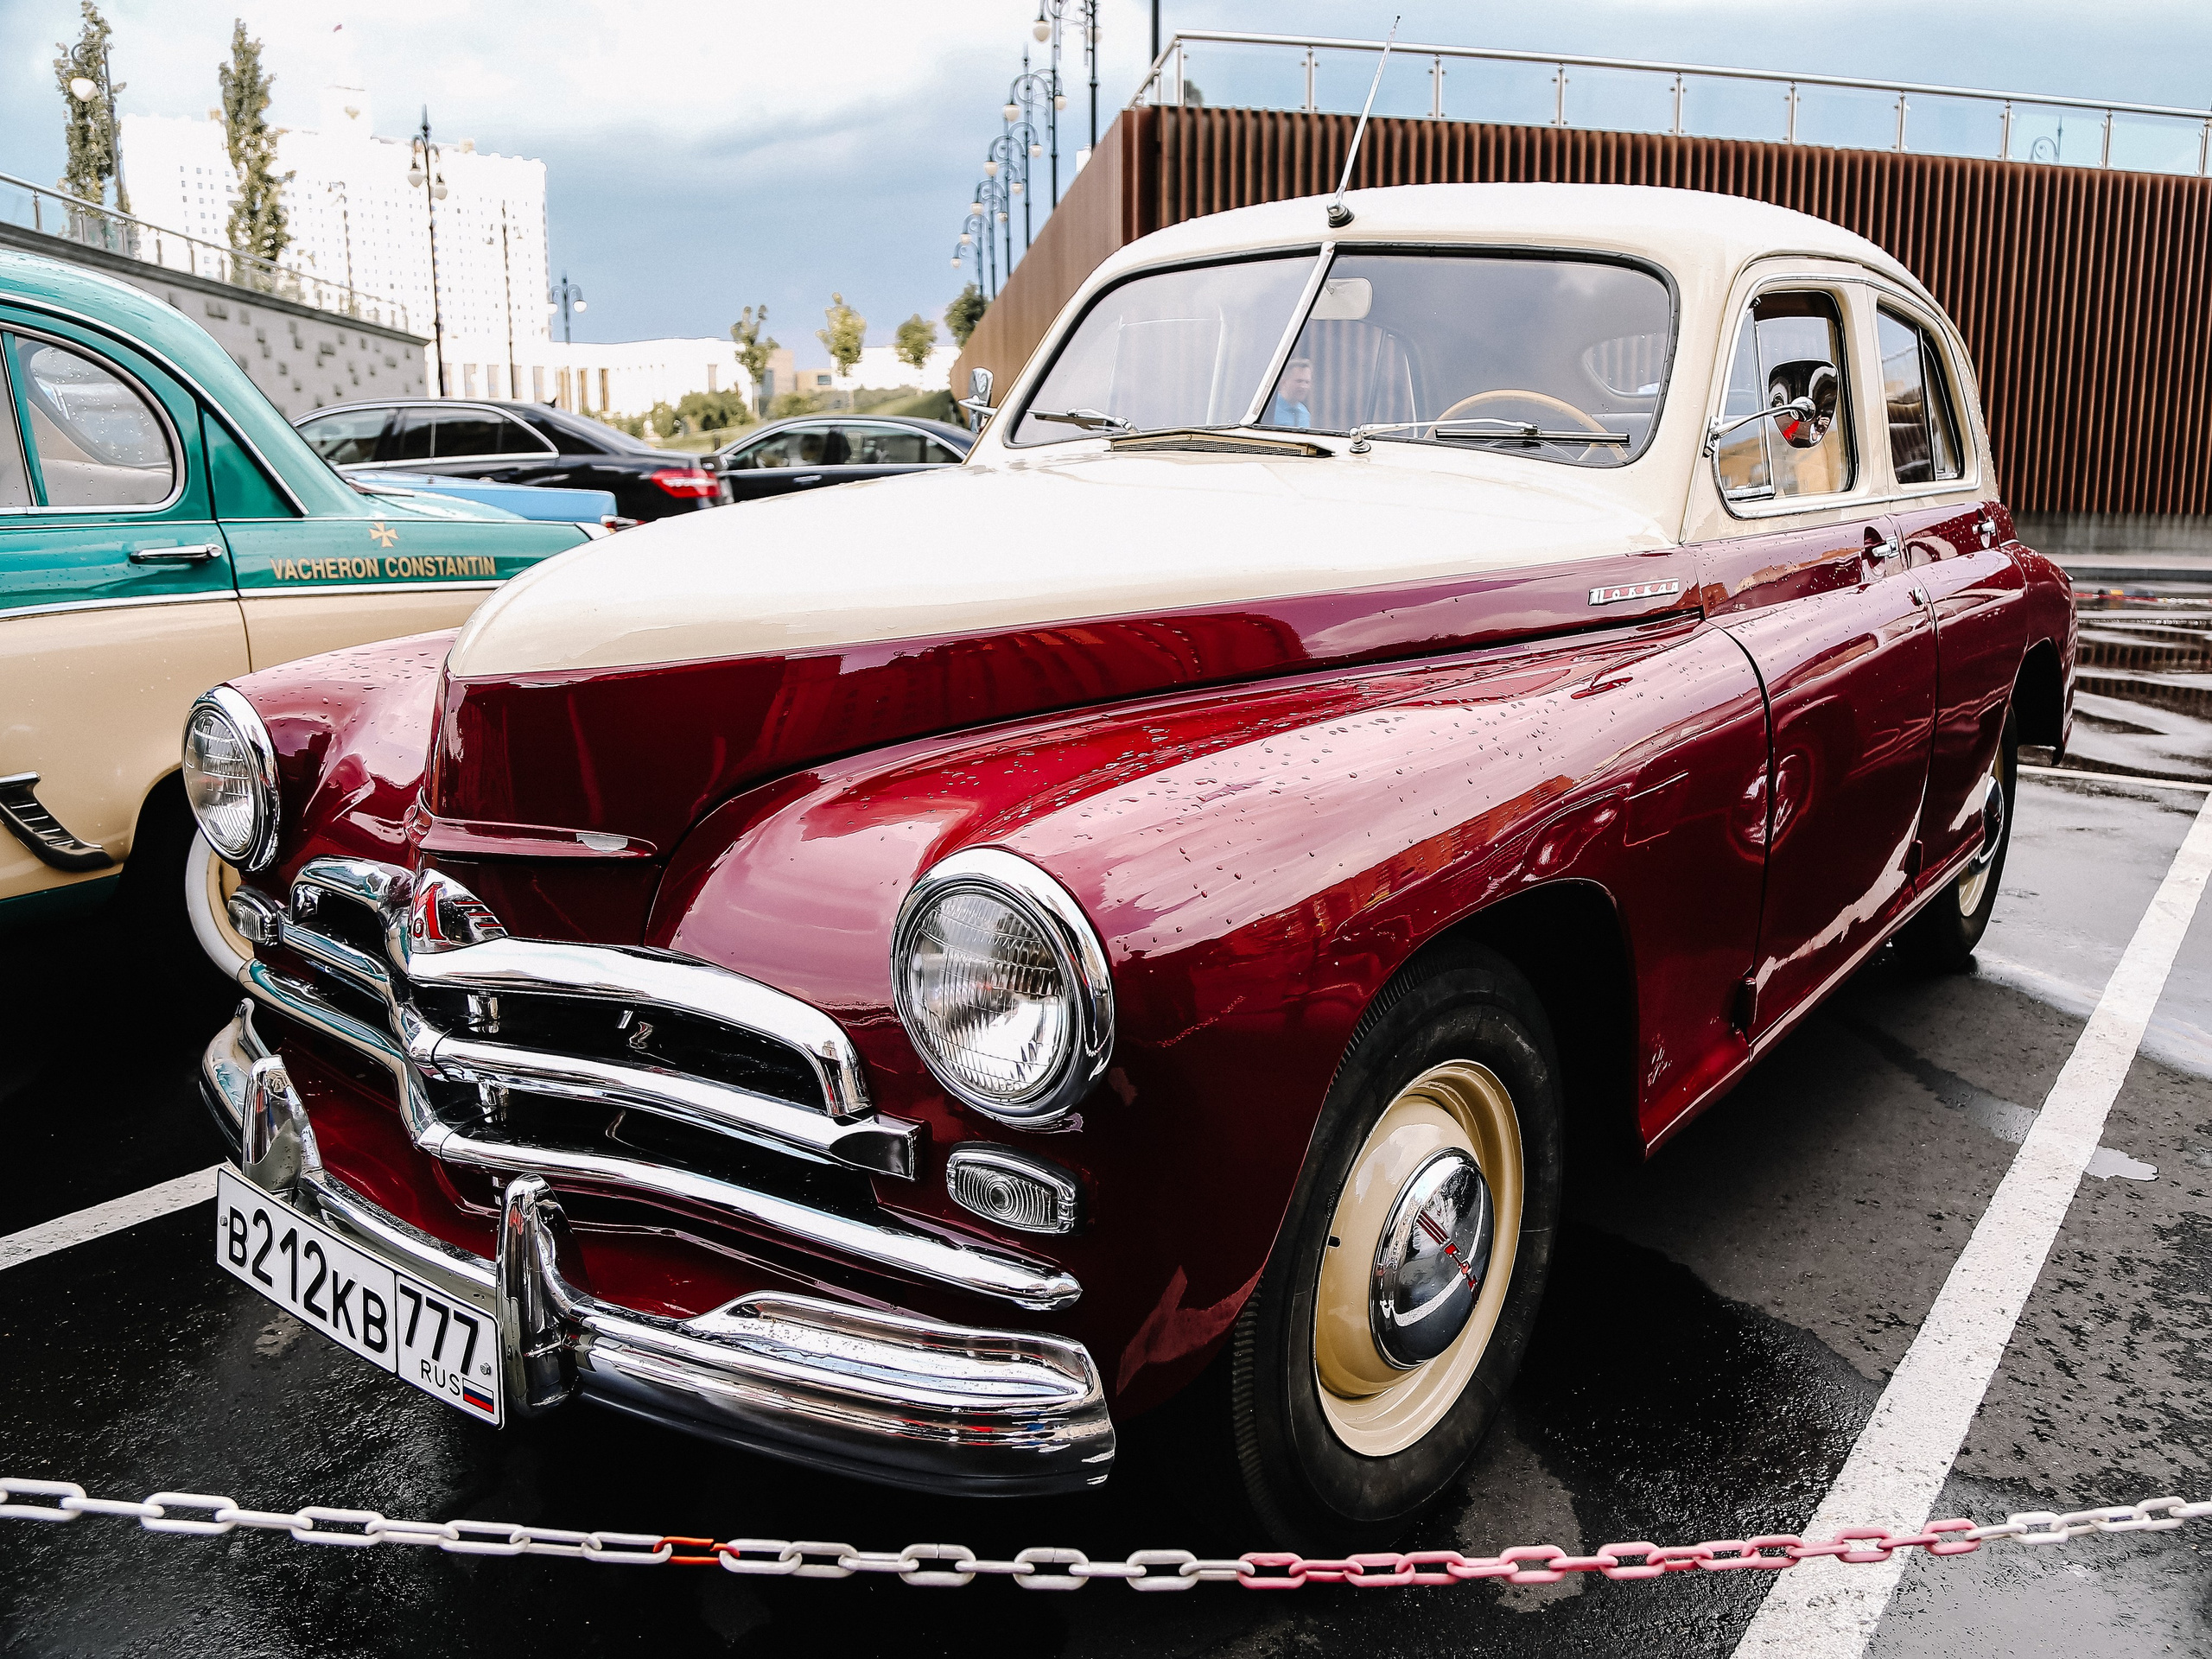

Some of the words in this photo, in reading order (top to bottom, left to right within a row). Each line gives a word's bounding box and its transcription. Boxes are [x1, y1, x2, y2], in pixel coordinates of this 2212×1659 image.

[270, 557, 380, 580] VACHERON
[385, 556, 496, 578] CONSTANTIN
[399, 1283, 479, 1376] 777
[420, 1358, 461, 1396] RUS
